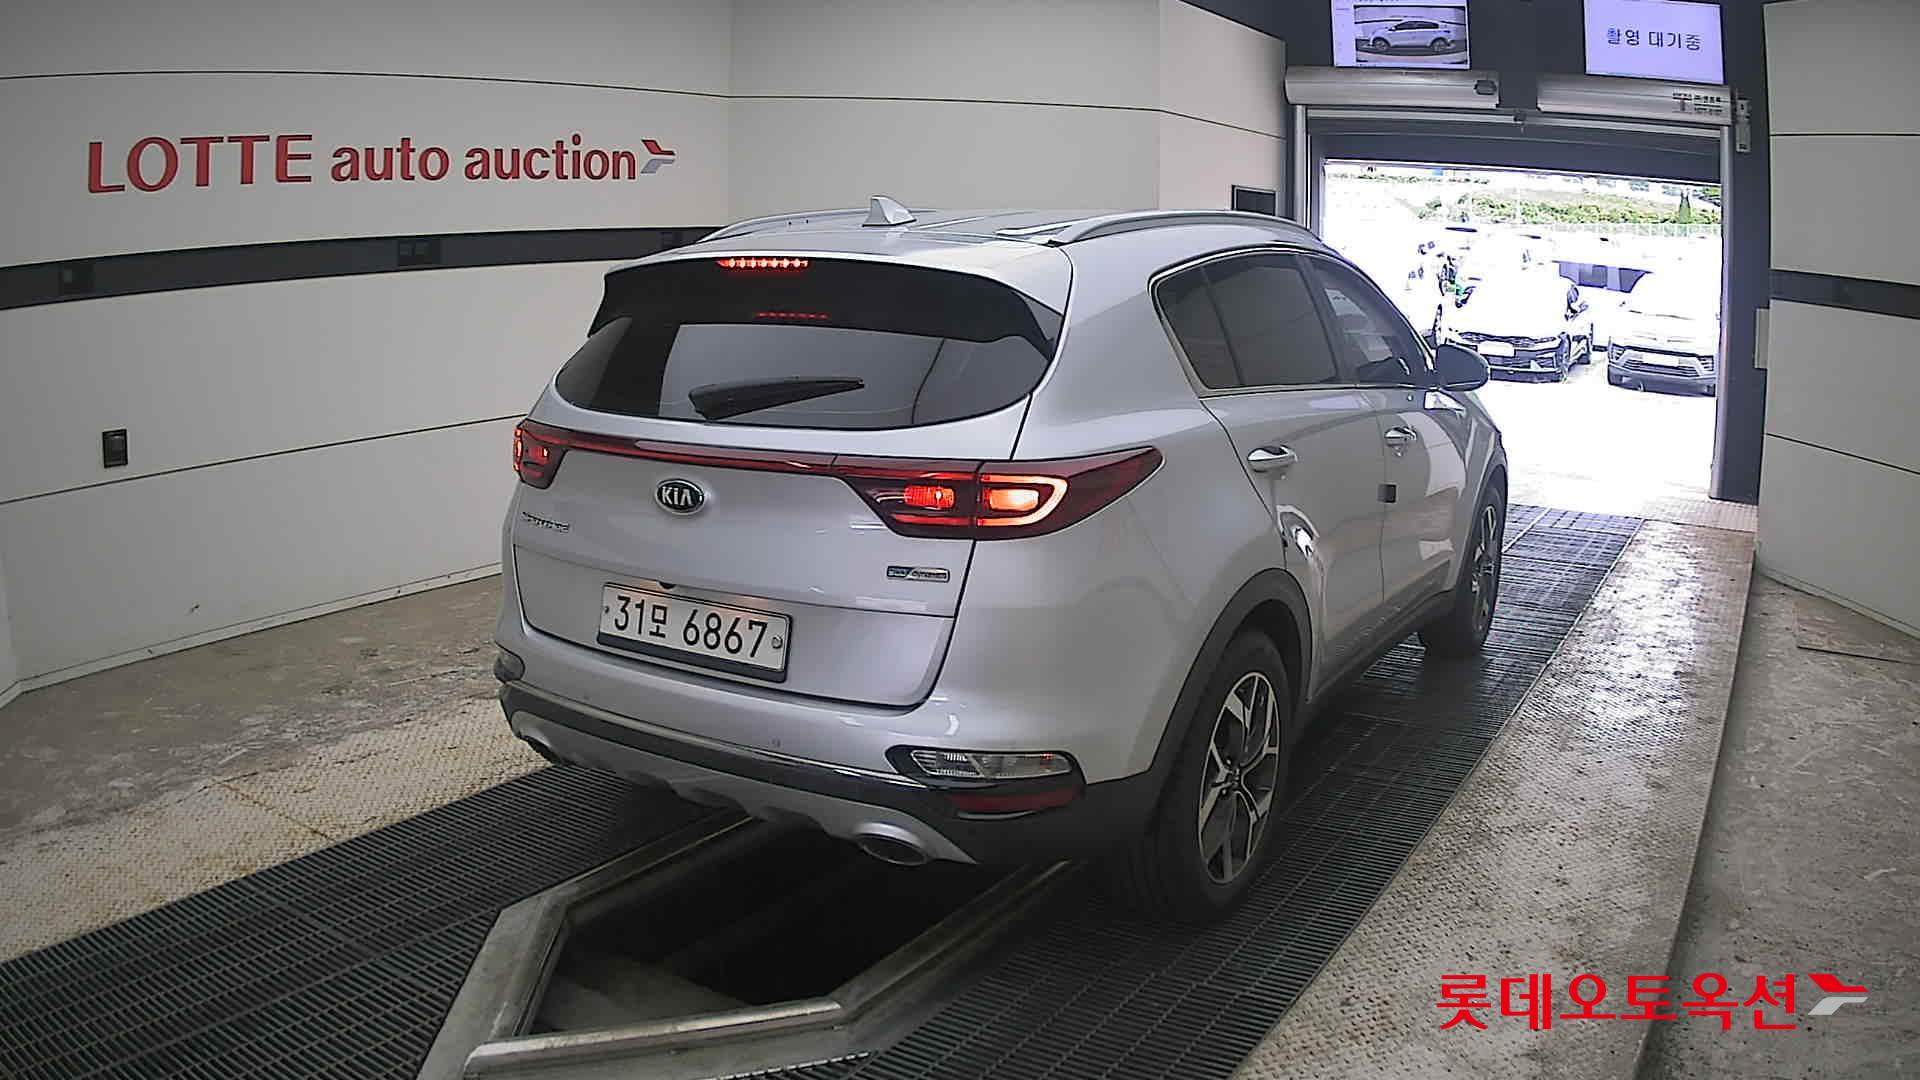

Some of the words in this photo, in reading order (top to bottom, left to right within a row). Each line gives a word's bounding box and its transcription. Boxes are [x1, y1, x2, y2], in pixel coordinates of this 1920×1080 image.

[1648, 31, 1701, 51] 대기중
[88, 134, 313, 193] LOTTE
[331, 137, 450, 181] auto
[464, 134, 637, 180] auction
[662, 486, 692, 506] KIA
[614, 595, 668, 638] 31모
[683, 609, 768, 658] 6867
